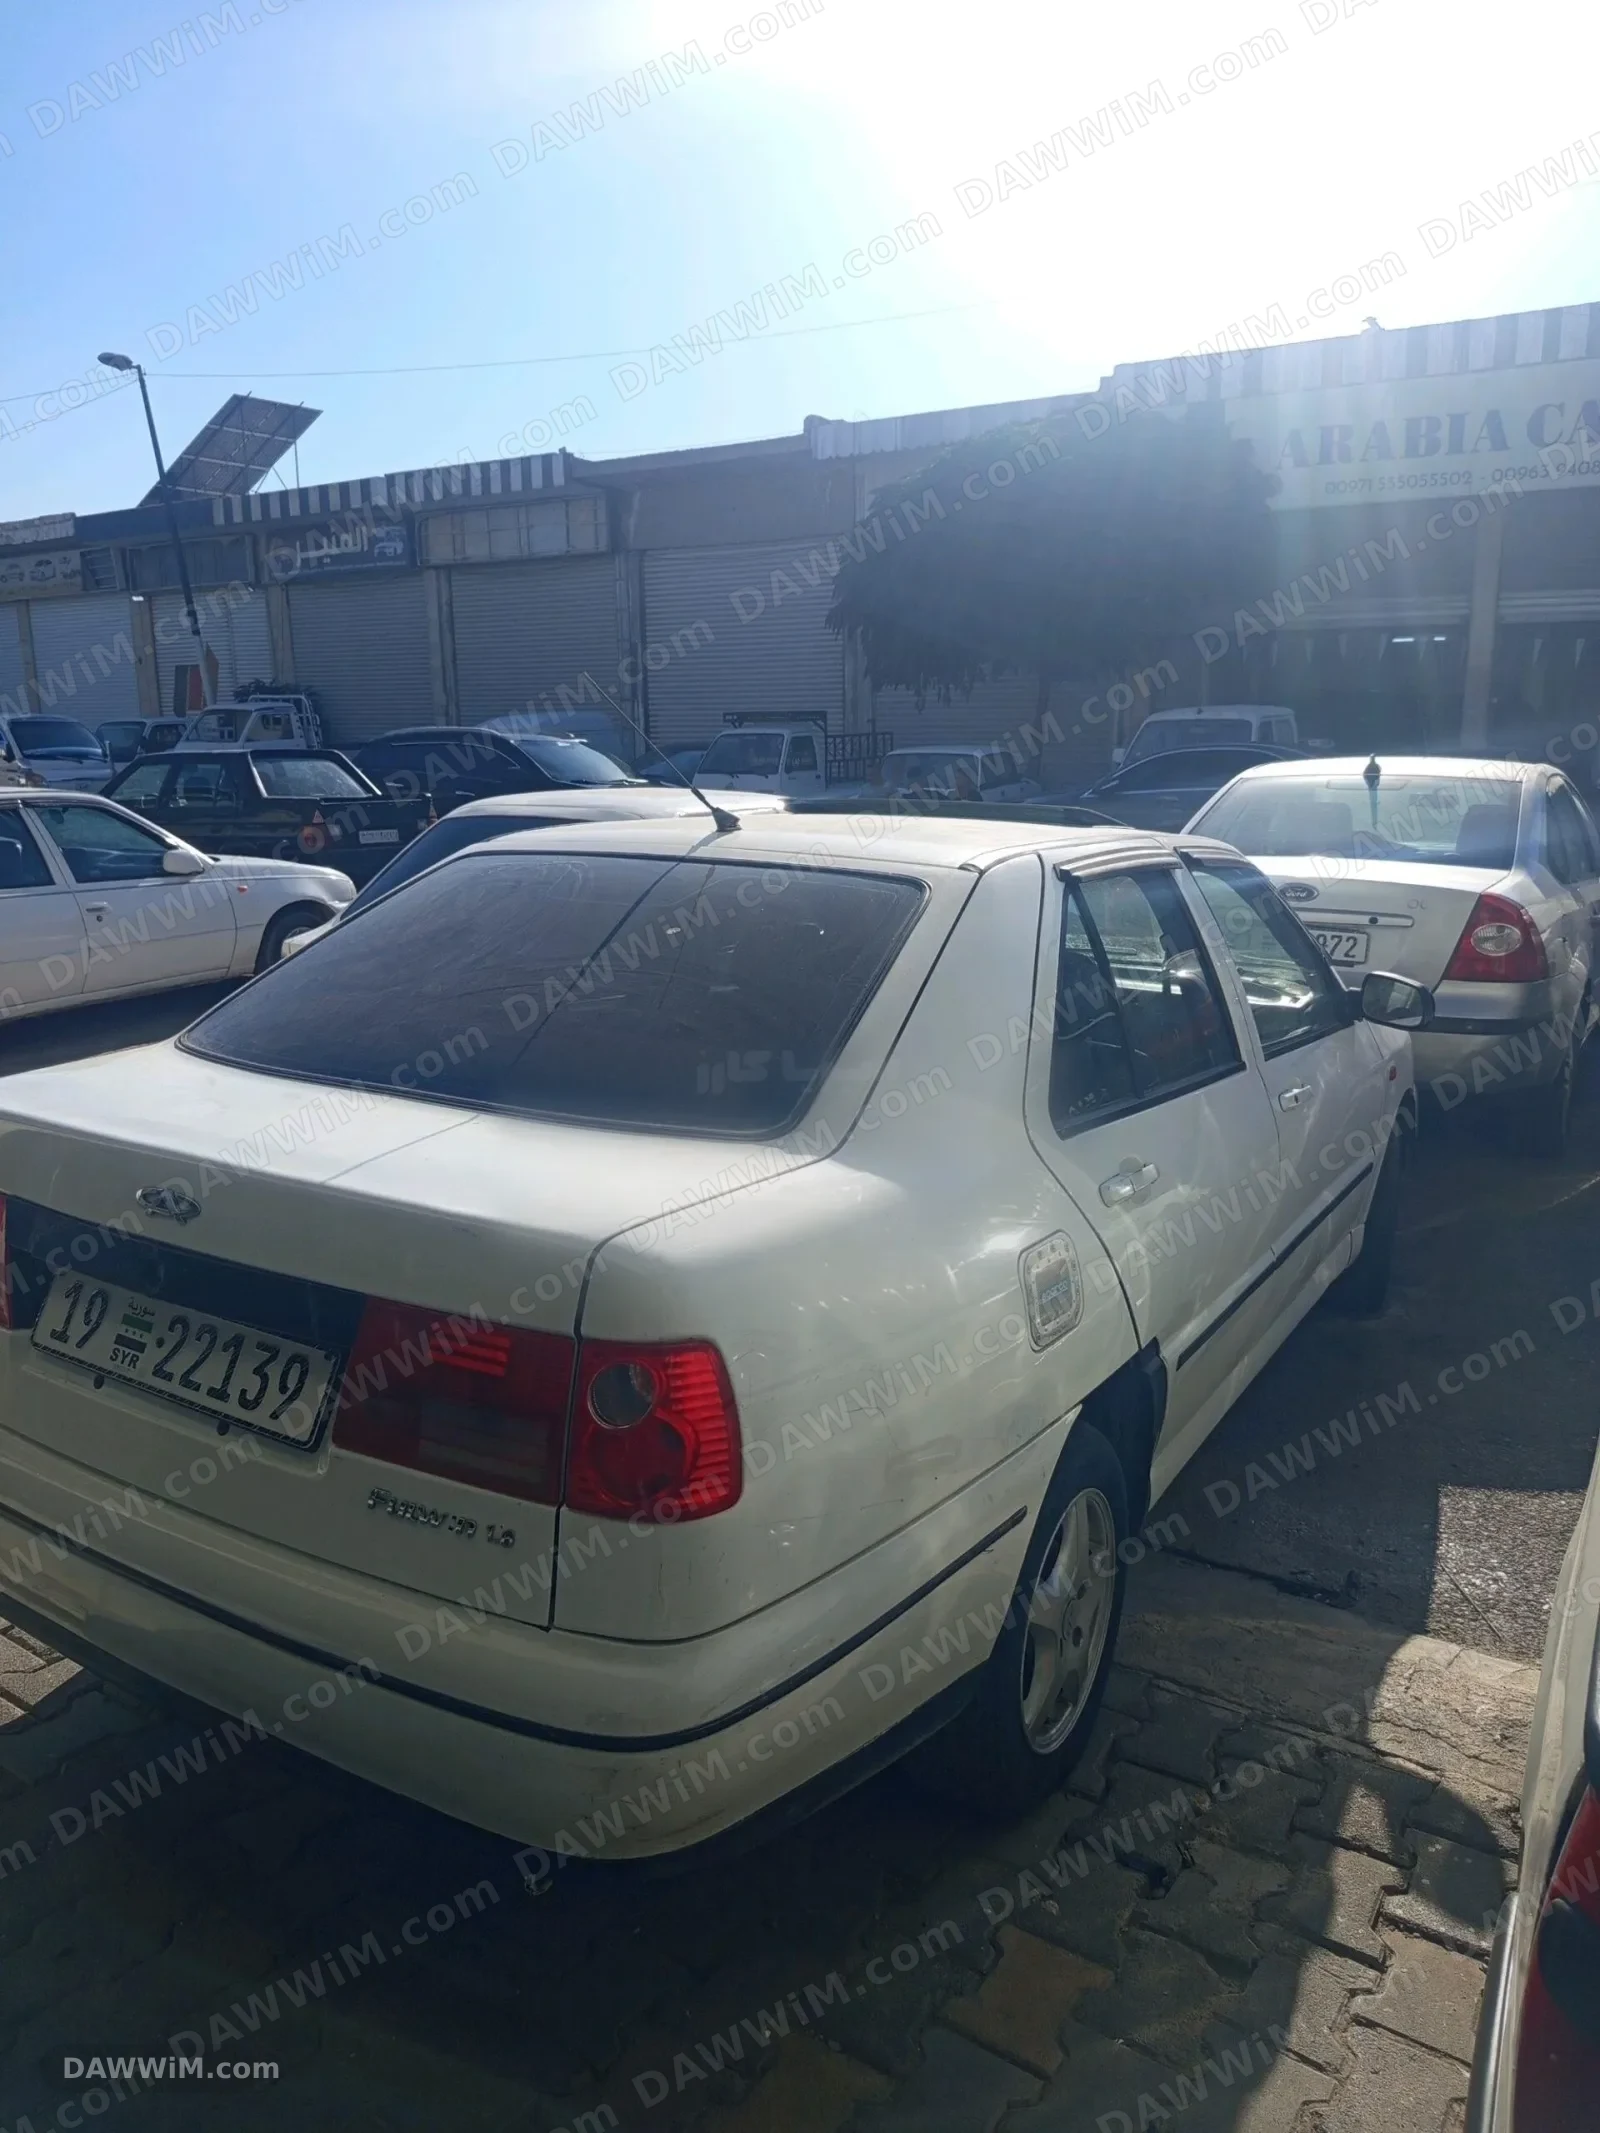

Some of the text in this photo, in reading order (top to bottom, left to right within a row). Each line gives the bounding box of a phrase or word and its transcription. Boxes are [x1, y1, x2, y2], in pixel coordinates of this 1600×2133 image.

[1276, 409, 1511, 470] ARABIA
[128, 1296, 156, 1317] سورية
[49, 1280, 310, 1420] 19 22139
[109, 1347, 140, 1370] SYR
